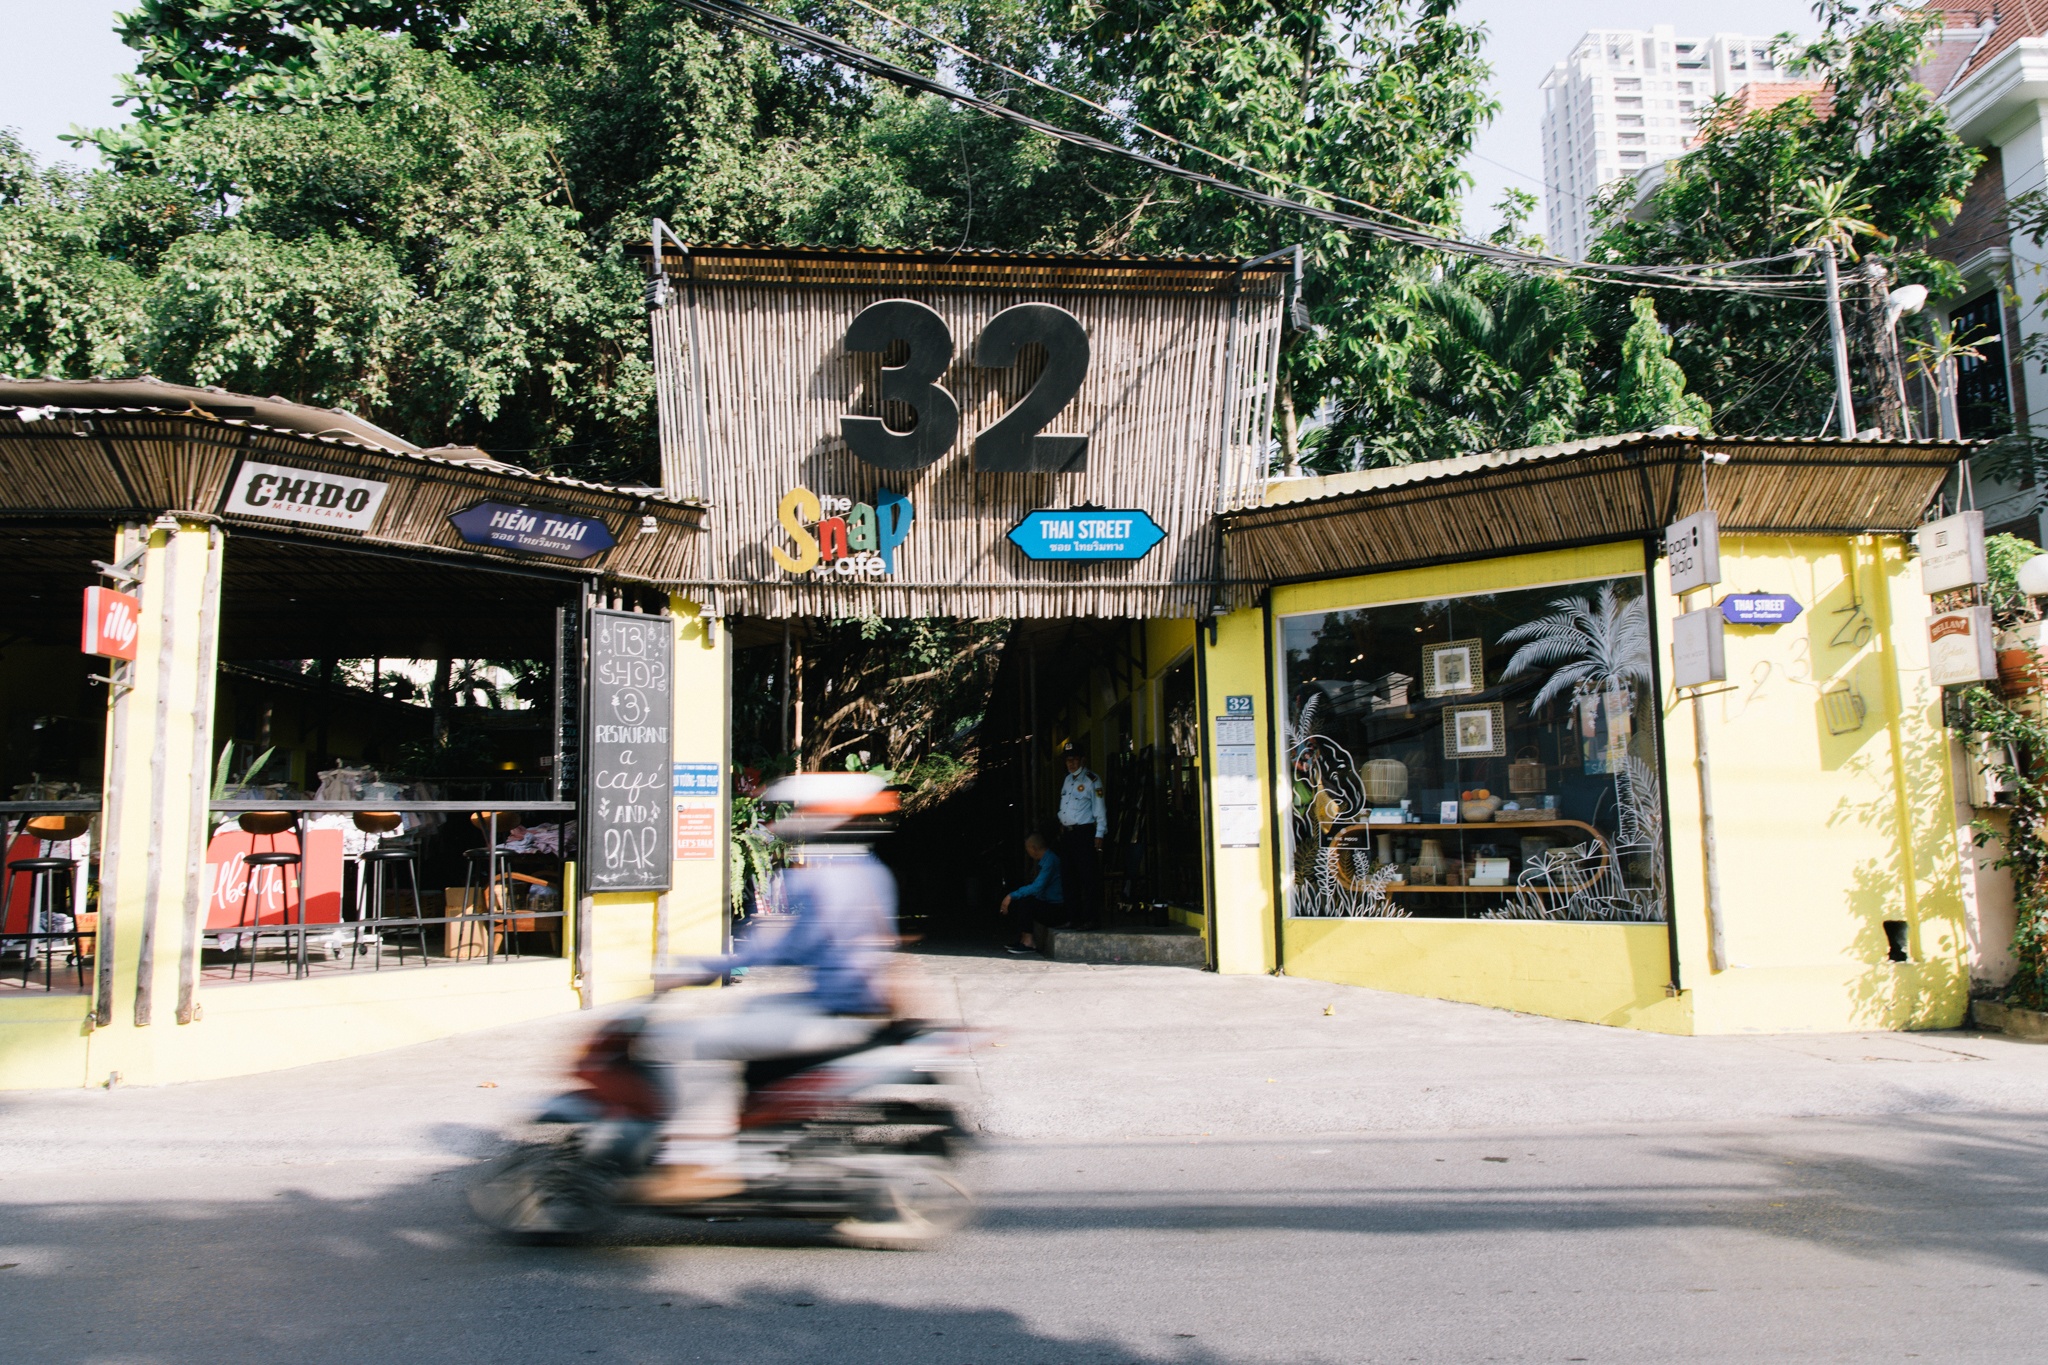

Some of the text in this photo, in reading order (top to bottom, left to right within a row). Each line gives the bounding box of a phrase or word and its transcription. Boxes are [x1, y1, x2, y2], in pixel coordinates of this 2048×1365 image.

[840, 298, 1090, 473] 32
[245, 473, 370, 513] CHIDO
[820, 494, 852, 512] the
[272, 502, 344, 518] MEXICAN
[541, 519, 588, 541] THÁI
[772, 487, 914, 575] Snap
[1040, 519, 1133, 540] THAI STREET
[1755, 599, 1785, 612] STREET
[103, 601, 138, 651] illy
[617, 626, 644, 656] 13
[623, 693, 640, 722] 3
[1229, 697, 1251, 711] 32
[595, 724, 668, 744] RESTAURANT
[620, 750, 637, 765] a
[596, 763, 666, 803] café
[612, 805, 647, 823] AND
[604, 825, 657, 869] BAR
[677, 838, 714, 849] LET'S TALK
